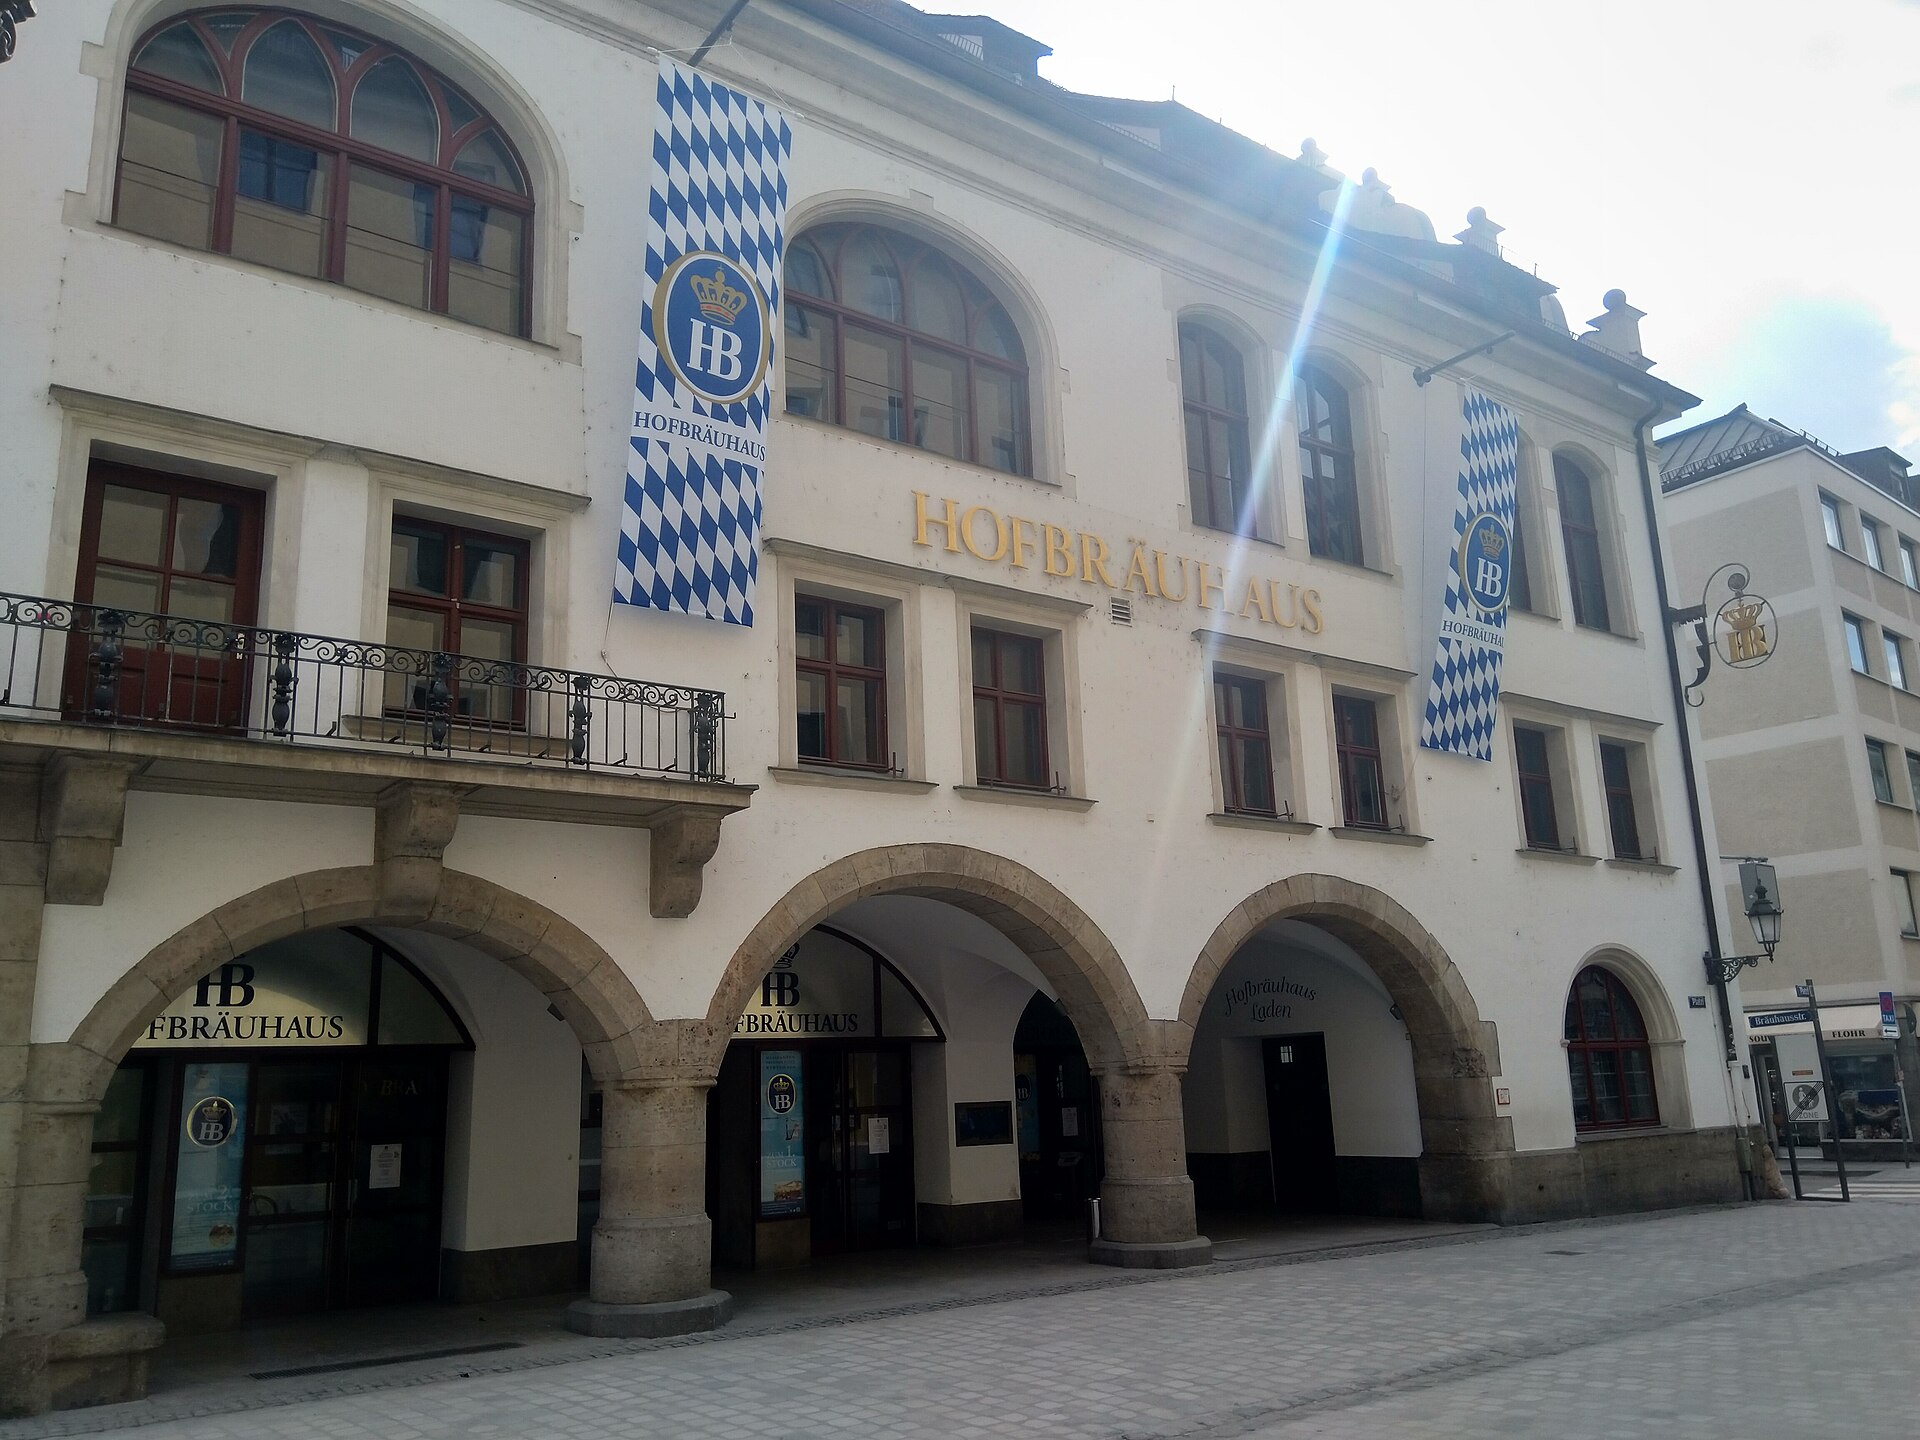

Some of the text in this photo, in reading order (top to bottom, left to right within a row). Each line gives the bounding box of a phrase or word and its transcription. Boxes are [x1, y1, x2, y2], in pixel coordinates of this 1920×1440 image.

[687, 318, 742, 381] HB
[634, 411, 767, 462] HOFBRÄUHAUS
[911, 489, 1324, 635] HOFBRÄUHAUS
[1475, 557, 1502, 598] HB
[193, 963, 254, 1007] HB
[761, 972, 800, 1007] HB
[1225, 976, 1317, 1016] Hofbräuhaus
[733, 1010, 858, 1033] FBRÄUHAUS
[1251, 999, 1291, 1022] Laden
[1754, 1013, 1807, 1025] Bräuhausstr.
[145, 1011, 344, 1040] FBRÄUHAUS
[1832, 1030, 1866, 1038] FLOHR
[774, 1094, 791, 1110] HB
[1799, 1111, 1820, 1119] ZONE
[199, 1122, 224, 1141] HB
